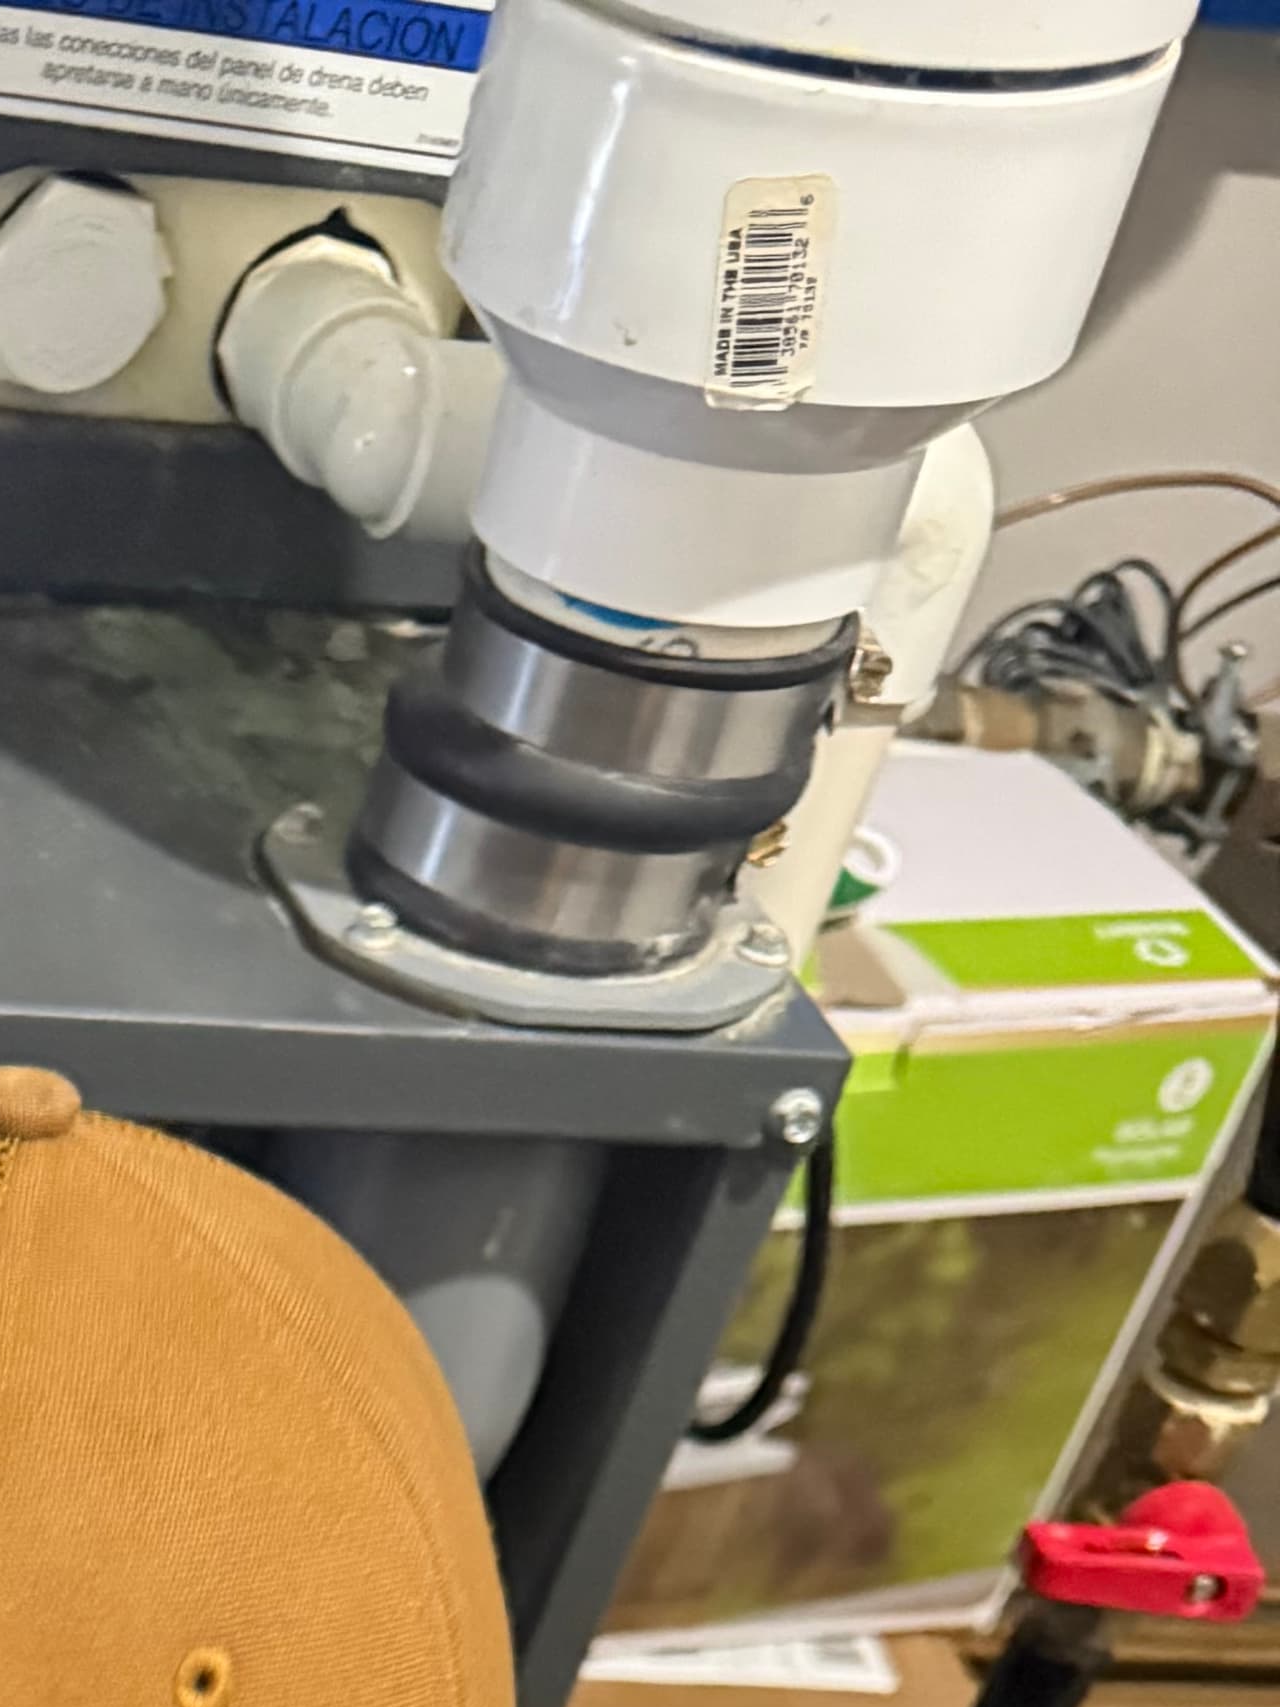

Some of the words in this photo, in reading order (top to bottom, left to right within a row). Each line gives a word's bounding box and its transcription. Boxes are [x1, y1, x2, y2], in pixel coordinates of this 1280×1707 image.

[24, 25, 54, 50] las
[58, 34, 181, 68] conecciones
[184, 50, 219, 72] del
[217, 55, 276, 80] panel
[278, 62, 305, 84] de
[366, 75, 431, 102] deben
[40, 61, 136, 90] apretarse
[139, 74, 152, 93] a
[156, 76, 213, 102] mano
[726, 227, 744, 264] USA
[787, 237, 810, 294] 70132
[721, 269, 739, 303] THE
[719, 306, 735, 324] IN
[714, 328, 732, 377] MADE
